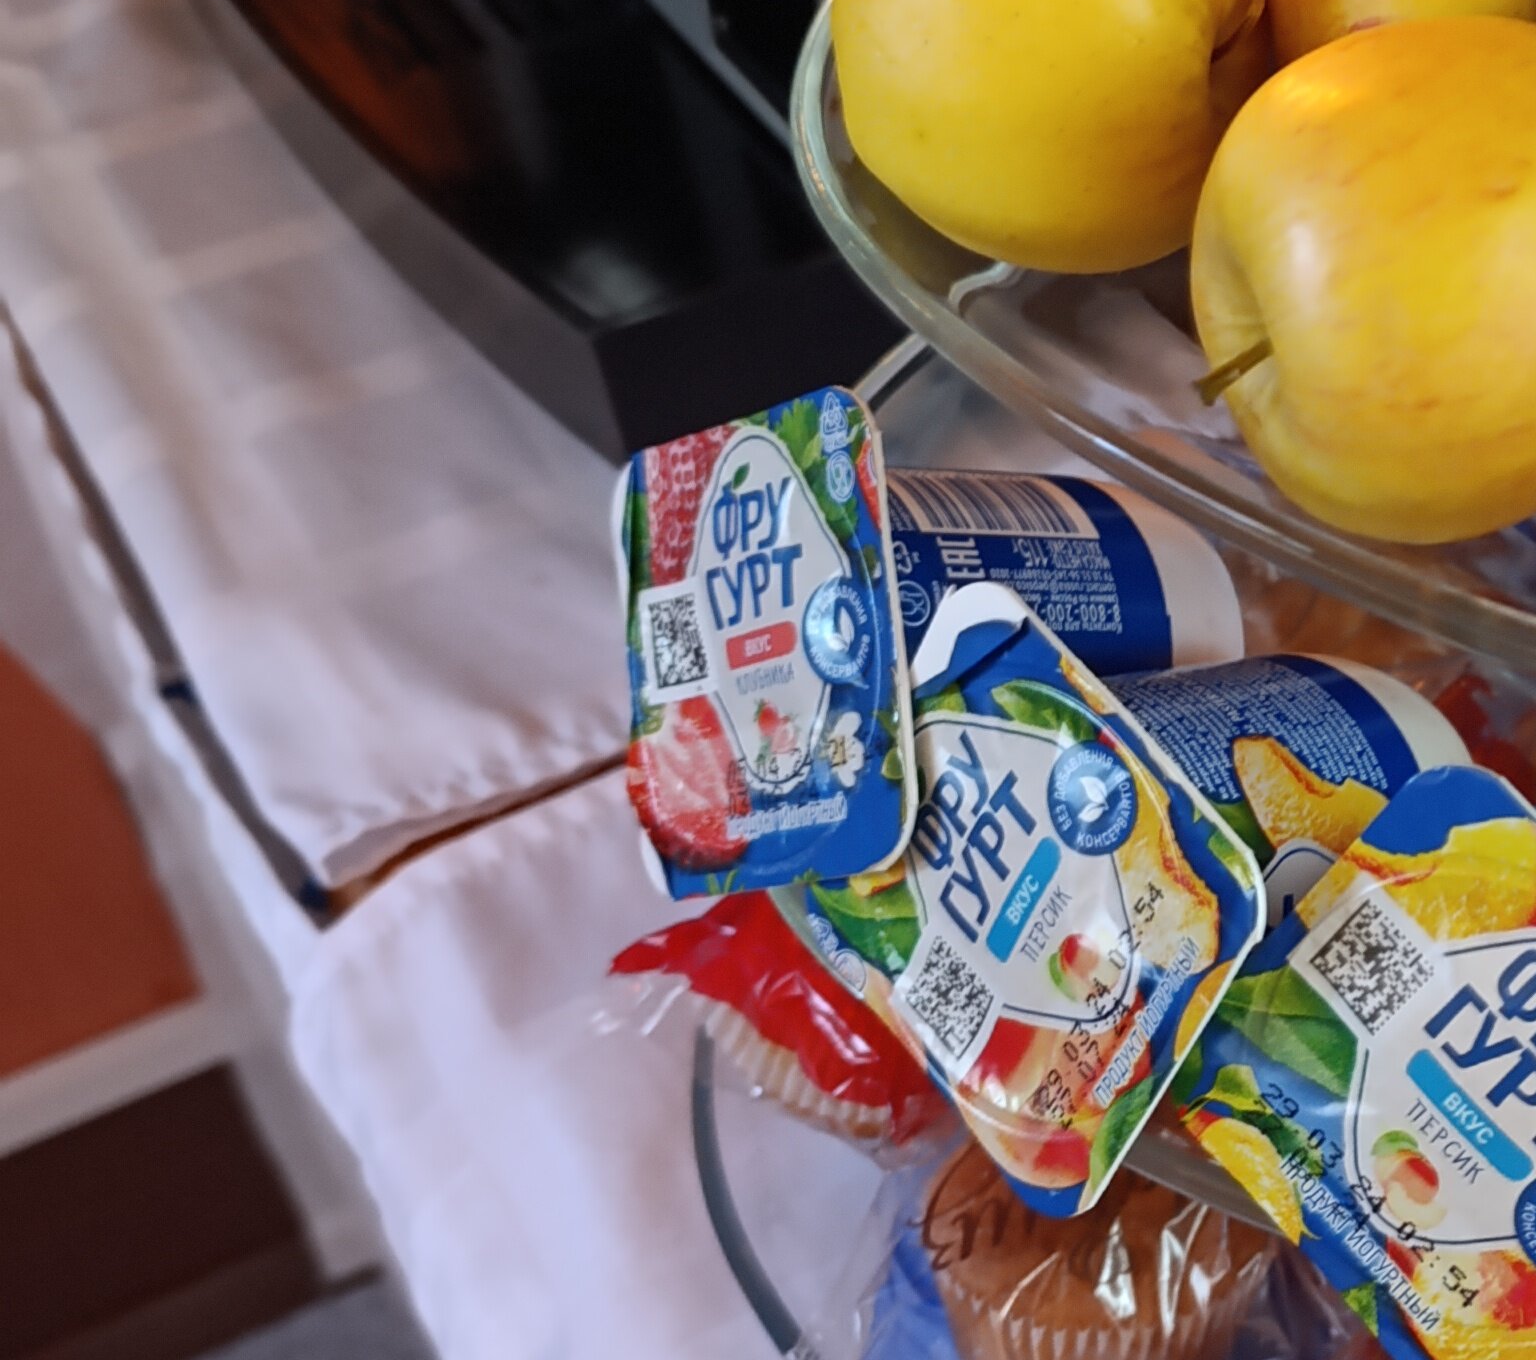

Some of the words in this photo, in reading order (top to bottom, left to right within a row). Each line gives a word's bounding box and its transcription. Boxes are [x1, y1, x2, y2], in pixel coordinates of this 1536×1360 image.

[712, 476, 794, 560] ФРУ
[706, 544, 803, 630] ГУРТ
[911, 729, 990, 871] ФРУ
[1053, 800, 1073, 832] БЕЗ
[1054, 747, 1115, 802] ДОБАВЛЕНИЯ
[939, 769, 1038, 943] ГУРТ
[1005, 874, 1041, 927] ВКУС
[1020, 885, 1073, 963] ПЕРСИК
[1093, 1032, 1145, 1109] ПРОДУКТ
[1138, 936, 1200, 1043] ЙОГУРТНЫЙ
[1405, 1098, 1488, 1185] ПЕРСИК
[1442, 1091, 1496, 1145] ВКУС
[1345, 1218, 1443, 1332] ЙОГУРТНЫЙ
[1397, 1220, 1481, 1308] 02:54
